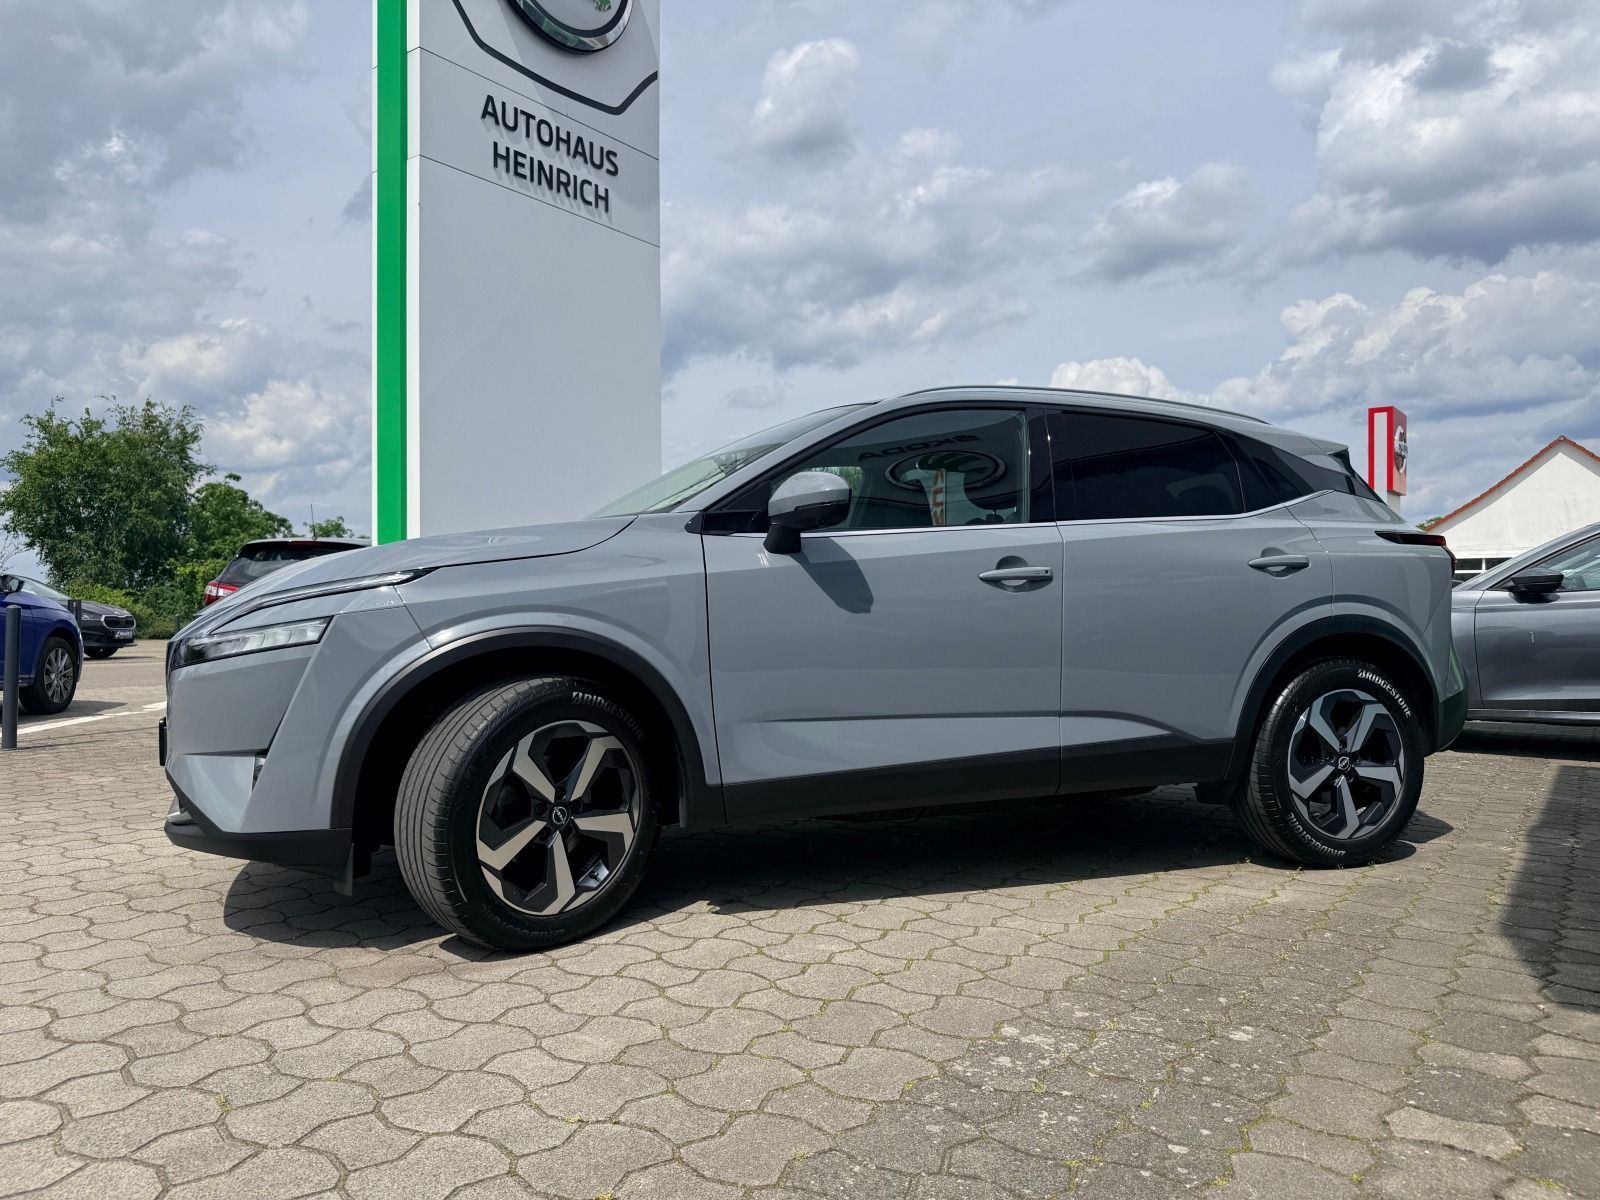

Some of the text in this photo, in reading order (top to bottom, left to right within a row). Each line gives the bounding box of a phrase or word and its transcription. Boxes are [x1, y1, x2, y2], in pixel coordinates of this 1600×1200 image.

[480, 94, 619, 177] AUTOHAUS
[493, 141, 609, 213] HEINRICH
[1357, 668, 1412, 718] BRIDGESTONE
